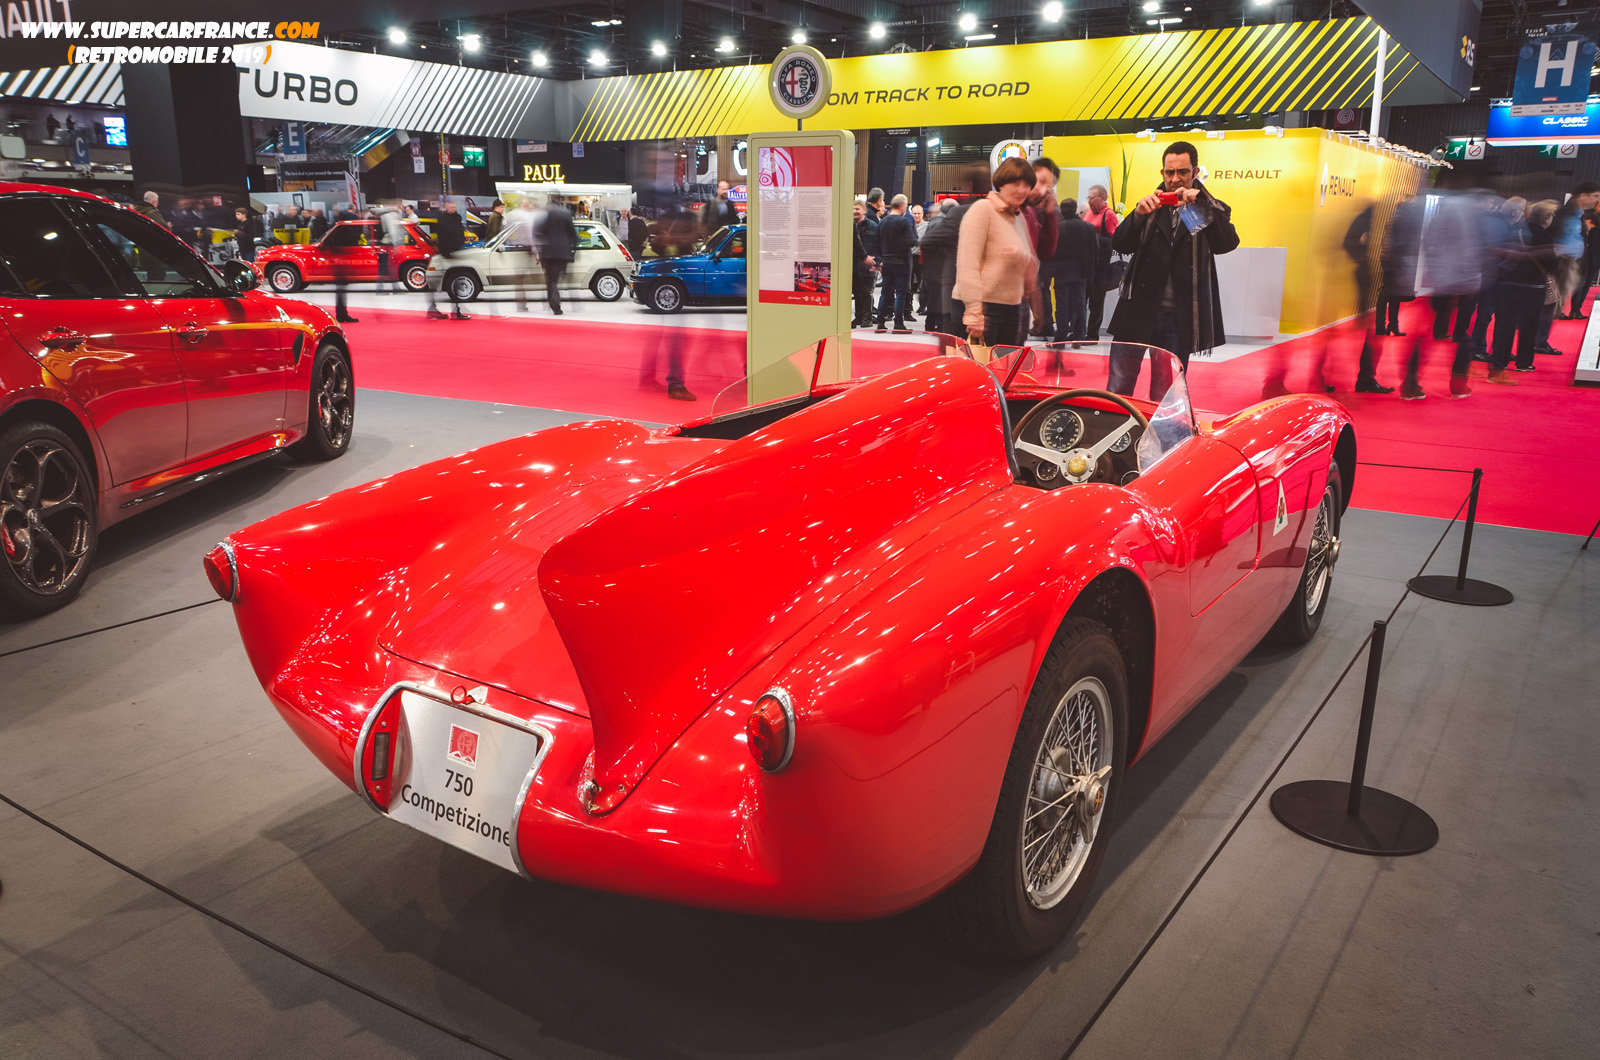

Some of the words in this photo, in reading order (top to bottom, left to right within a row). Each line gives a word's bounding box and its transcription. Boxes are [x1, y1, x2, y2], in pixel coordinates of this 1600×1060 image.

[0, 0, 72, 38] AULT
[780, 63, 793, 83] ALFA
[795, 60, 816, 82] ROMEO
[1534, 40, 1578, 88] H
[864, 87, 930, 104] TRACK
[935, 85, 962, 100] TO
[967, 81, 1030, 98] ROAD
[1542, 116, 1589, 124] CLASSIC
[287, 122, 300, 146] E
[76, 136, 86, 158] C
[523, 164, 565, 181] PAUL
[1214, 169, 1282, 180] RENAULT
[1328, 175, 1356, 197] RENAULT
[444, 768, 474, 797] 750
[401, 784, 510, 847] Competizione
